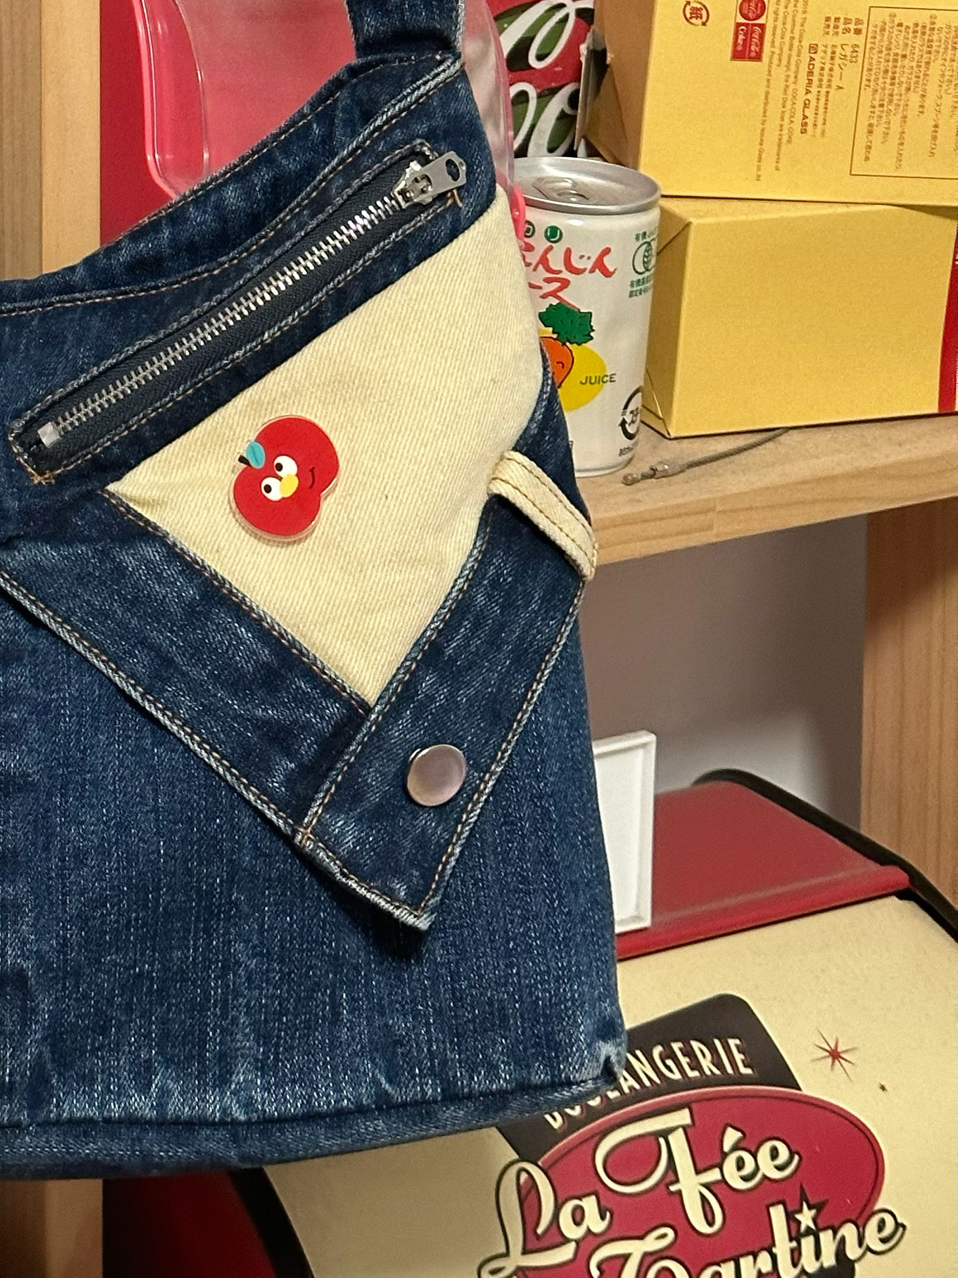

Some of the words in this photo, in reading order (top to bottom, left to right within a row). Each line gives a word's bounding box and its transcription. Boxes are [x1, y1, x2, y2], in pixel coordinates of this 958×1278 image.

[848, 43, 859, 64] 6433
[804, 55, 816, 96] ADERIA
[799, 98, 811, 134] GLASS
[527, 276, 580, 311] ース
[580, 373, 616, 386] JUICE
[544, 1037, 754, 1130] ANGERIE
[478, 1159, 610, 1278] La
[595, 1106, 799, 1235] Fée
